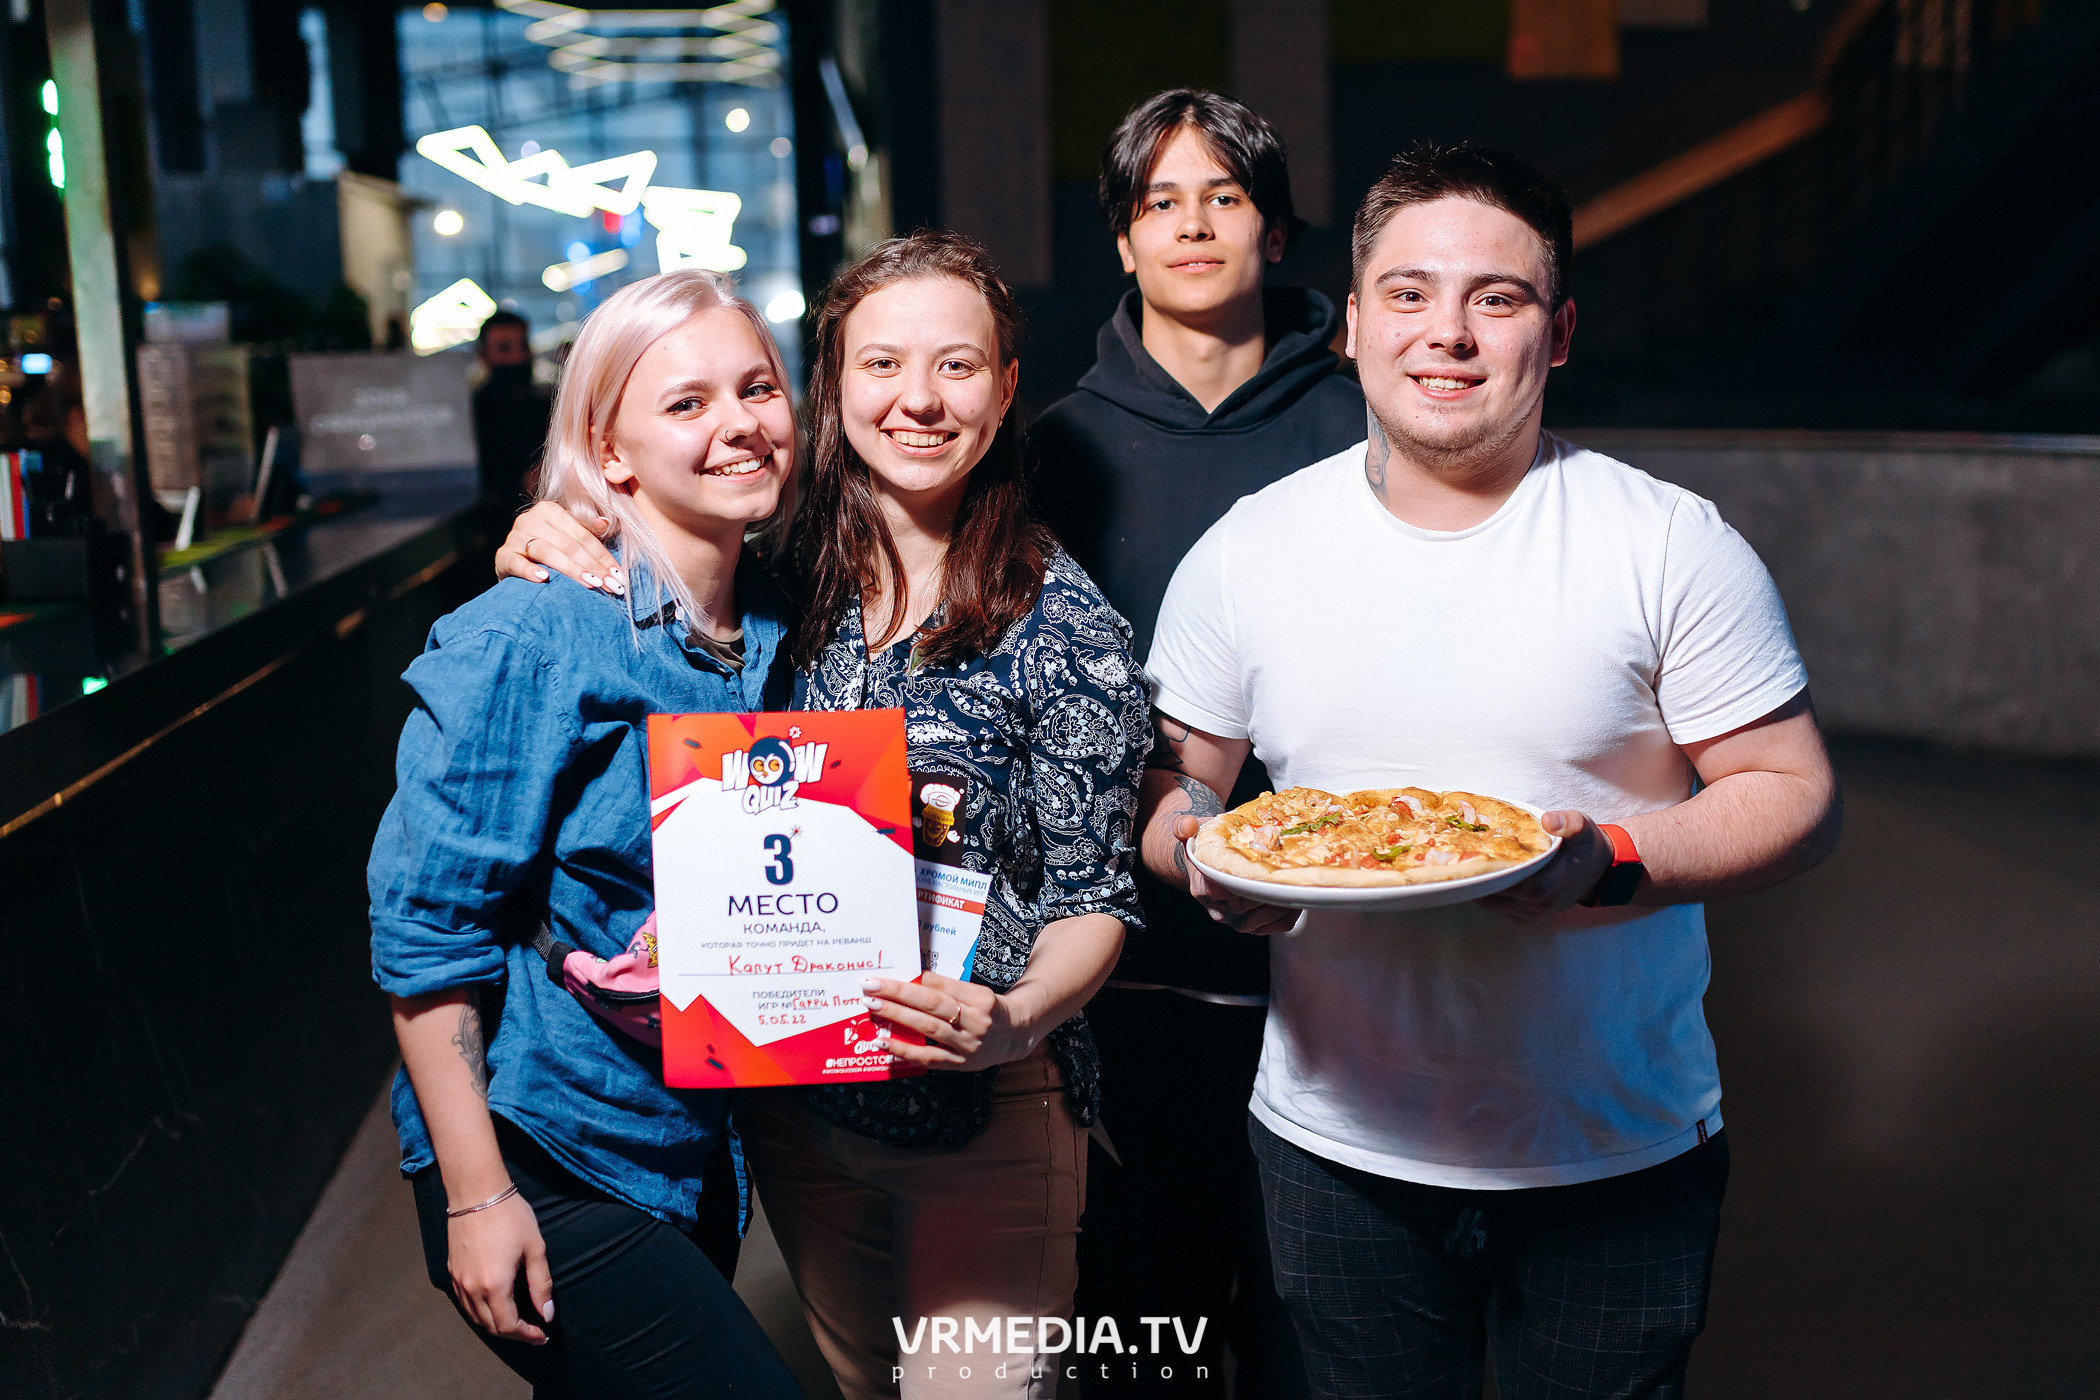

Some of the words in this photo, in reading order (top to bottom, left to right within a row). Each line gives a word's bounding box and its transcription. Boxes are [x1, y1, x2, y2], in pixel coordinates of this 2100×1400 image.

[742, 781, 800, 815] QUIZ
[763, 834, 794, 885] 3
[920, 867, 959, 884] ХРОМОЙ
[960, 877, 988, 890] МИПЛ
[728, 892, 839, 916] МЕСТО
[917, 890, 966, 910] РТИФИКАТ
[743, 921, 826, 934] КОМАНДА,
[923, 922, 957, 936] рублей
[701, 941, 744, 950] КОТОРАЯ
[744, 940, 776, 949] ТОЧНО
[778, 939, 814, 948] ПРИДЕТ
[817, 938, 830, 947] НА
[832, 936, 872, 945] РЕВАНШ
[728, 954, 784, 976] Капут
[752, 989, 826, 999] ПОБЕДИТЕЛИ
[832, 995, 861, 1007] Потт
[758, 1002, 779, 1010] ИГР
